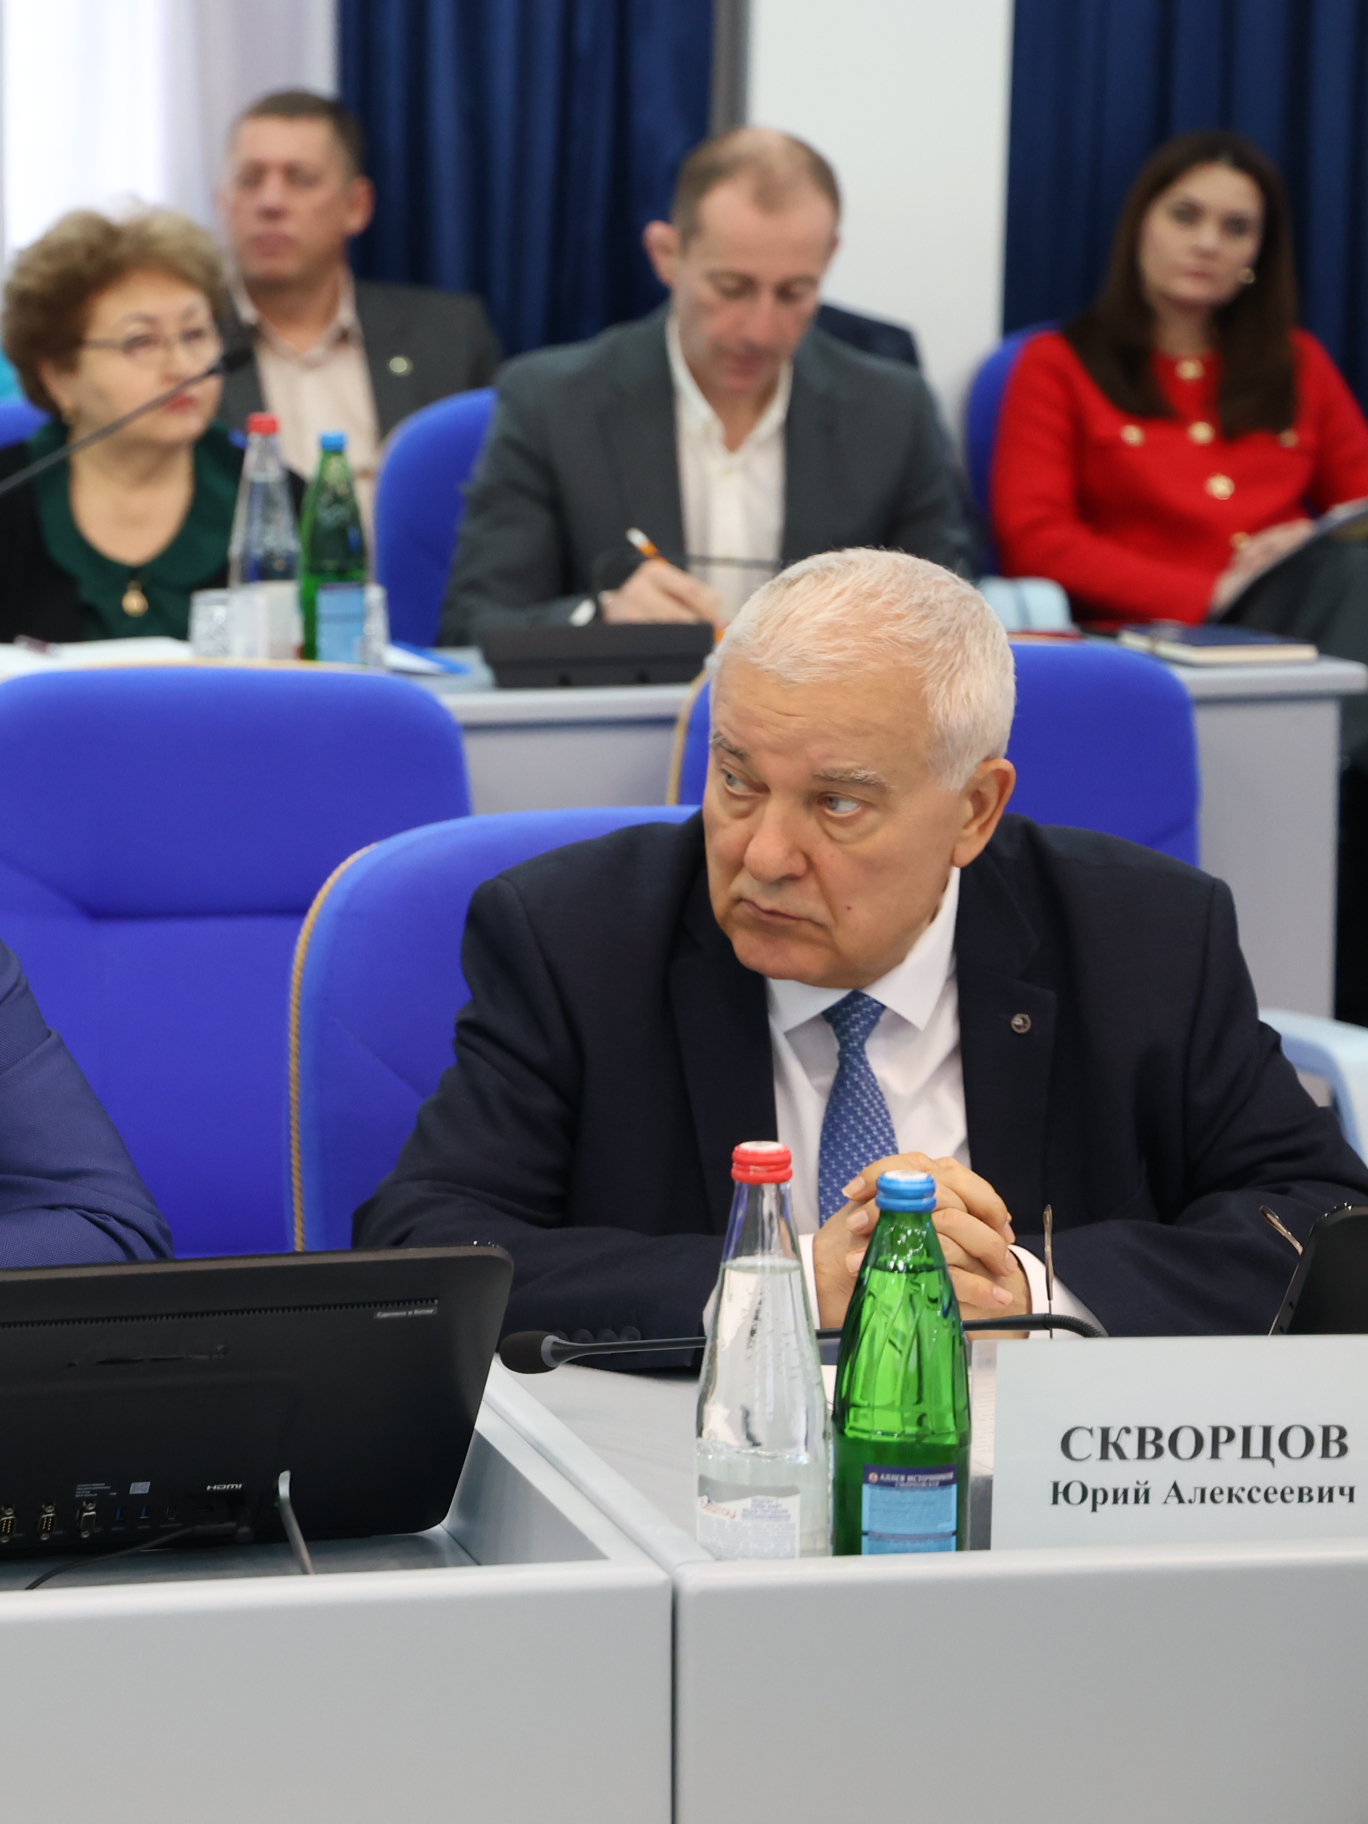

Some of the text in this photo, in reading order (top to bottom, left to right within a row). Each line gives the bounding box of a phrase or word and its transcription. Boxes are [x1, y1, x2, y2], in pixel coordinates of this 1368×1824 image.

[1059, 1423, 1351, 1469] СКВОРЦОВ
[206, 1483, 243, 1491] HDMI
[1049, 1479, 1357, 1513] Юрий Алексеевич
